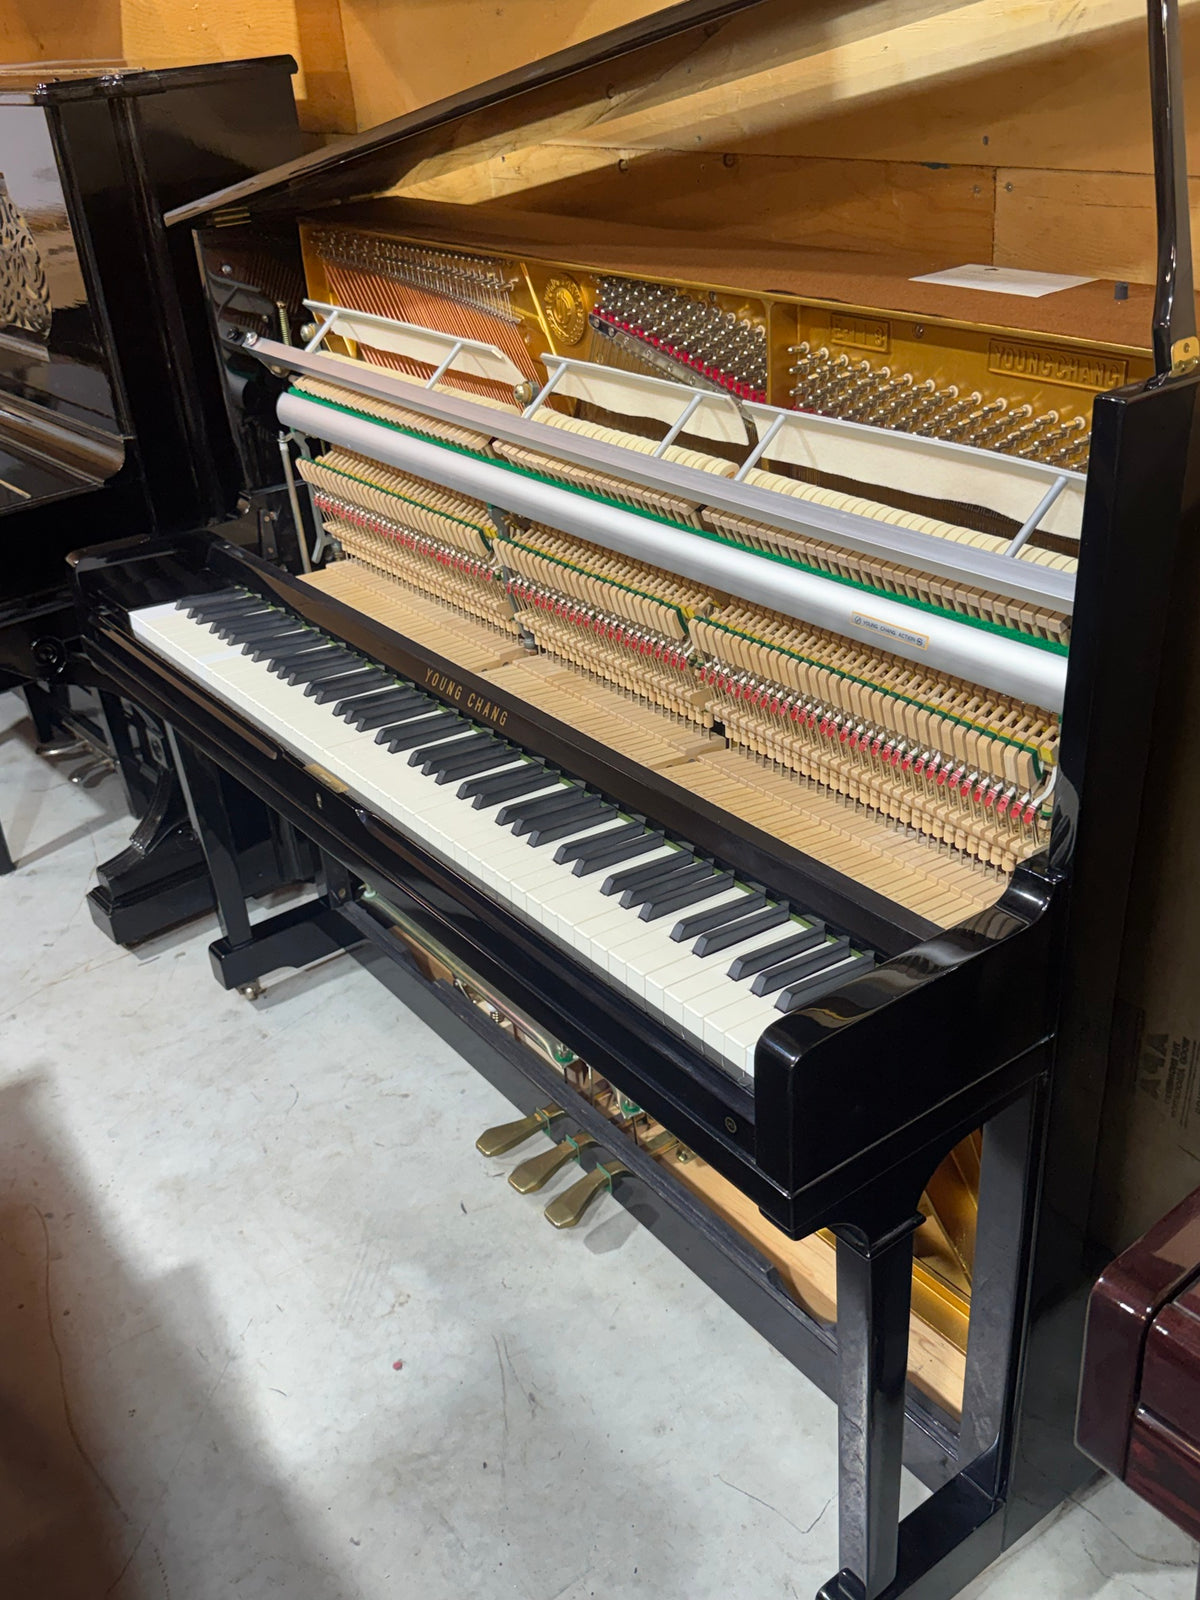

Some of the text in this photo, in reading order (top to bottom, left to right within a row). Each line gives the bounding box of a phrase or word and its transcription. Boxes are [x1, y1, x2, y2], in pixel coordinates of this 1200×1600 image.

[898, 632, 916, 643] ACTION
[424, 667, 508, 727] YOUNG CHANG
